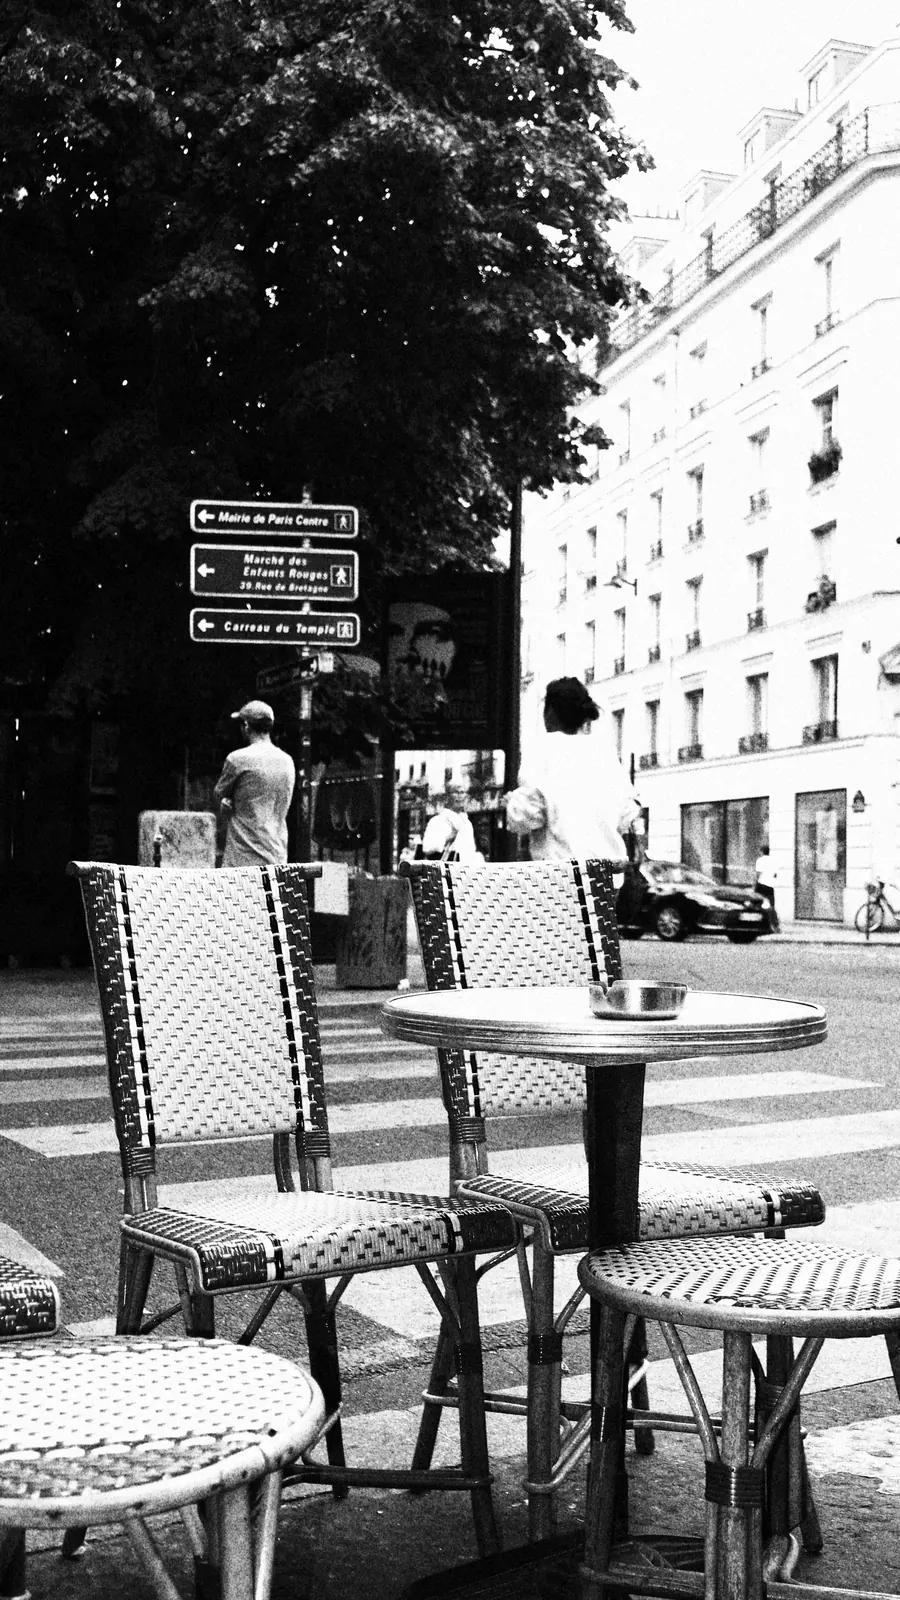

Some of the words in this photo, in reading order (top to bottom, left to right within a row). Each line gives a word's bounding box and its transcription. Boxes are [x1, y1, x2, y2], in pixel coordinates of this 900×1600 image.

[218, 511, 251, 523] Mairie
[253, 513, 266, 524] de
[268, 513, 293, 525] Paris
[295, 514, 329, 527] Centre
[243, 553, 285, 566] Marché
[288, 555, 307, 566] des
[243, 566, 285, 578] Enfants
[289, 568, 329, 582] Rouges
[255, 581, 273, 591] Rue
[275, 582, 286, 592] de
[288, 582, 329, 594] Bretagne
[224, 621, 271, 632] Carreau
[275, 622, 290, 633] du
[296, 622, 336, 636] Temple
